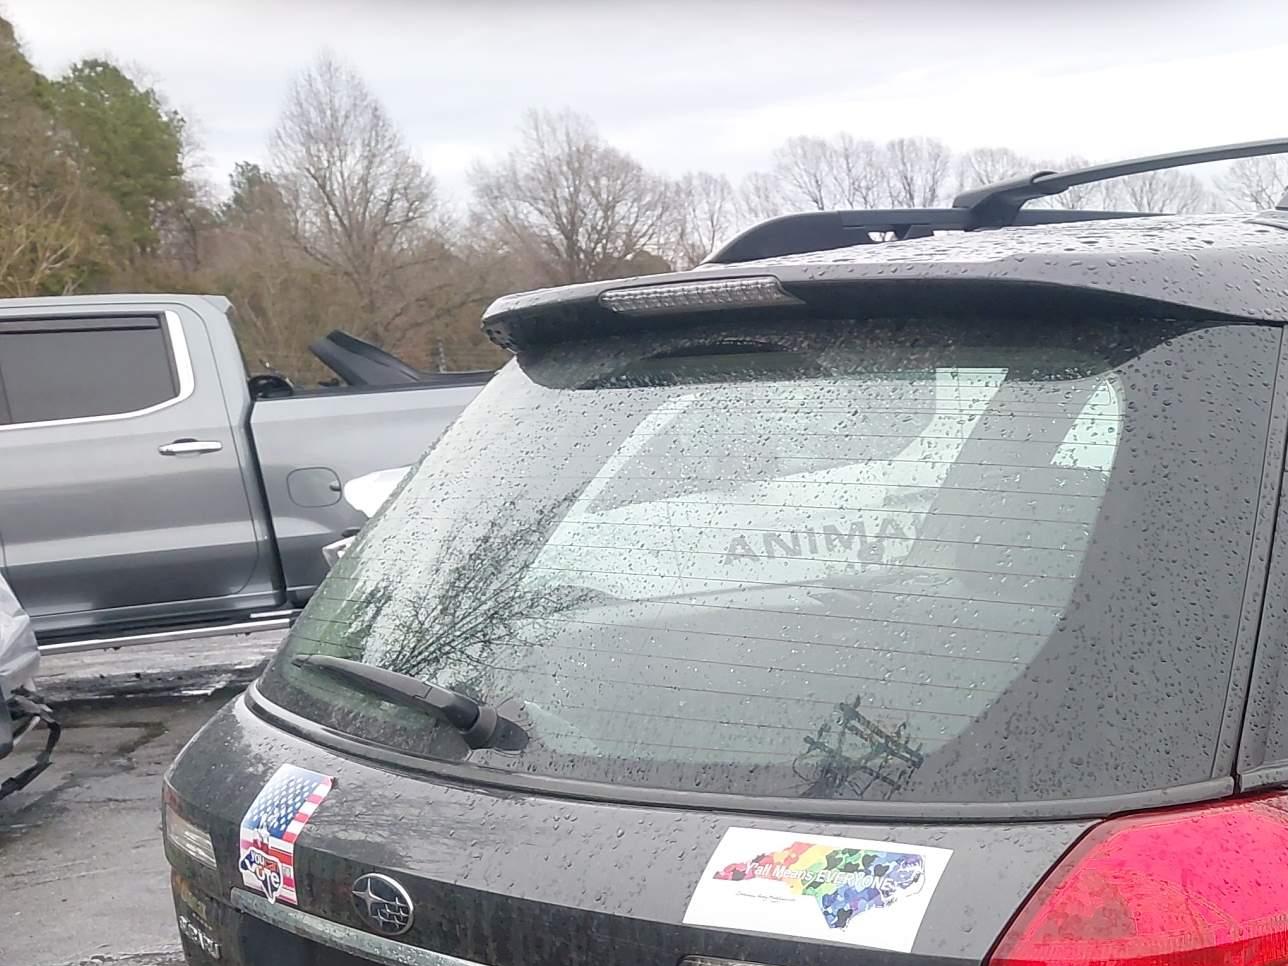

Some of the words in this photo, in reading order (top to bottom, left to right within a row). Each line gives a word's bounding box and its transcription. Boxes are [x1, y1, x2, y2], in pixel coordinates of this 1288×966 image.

[745, 861, 771, 878] Y'all
[771, 863, 814, 882] Means
[814, 868, 897, 891] EVERYONE
